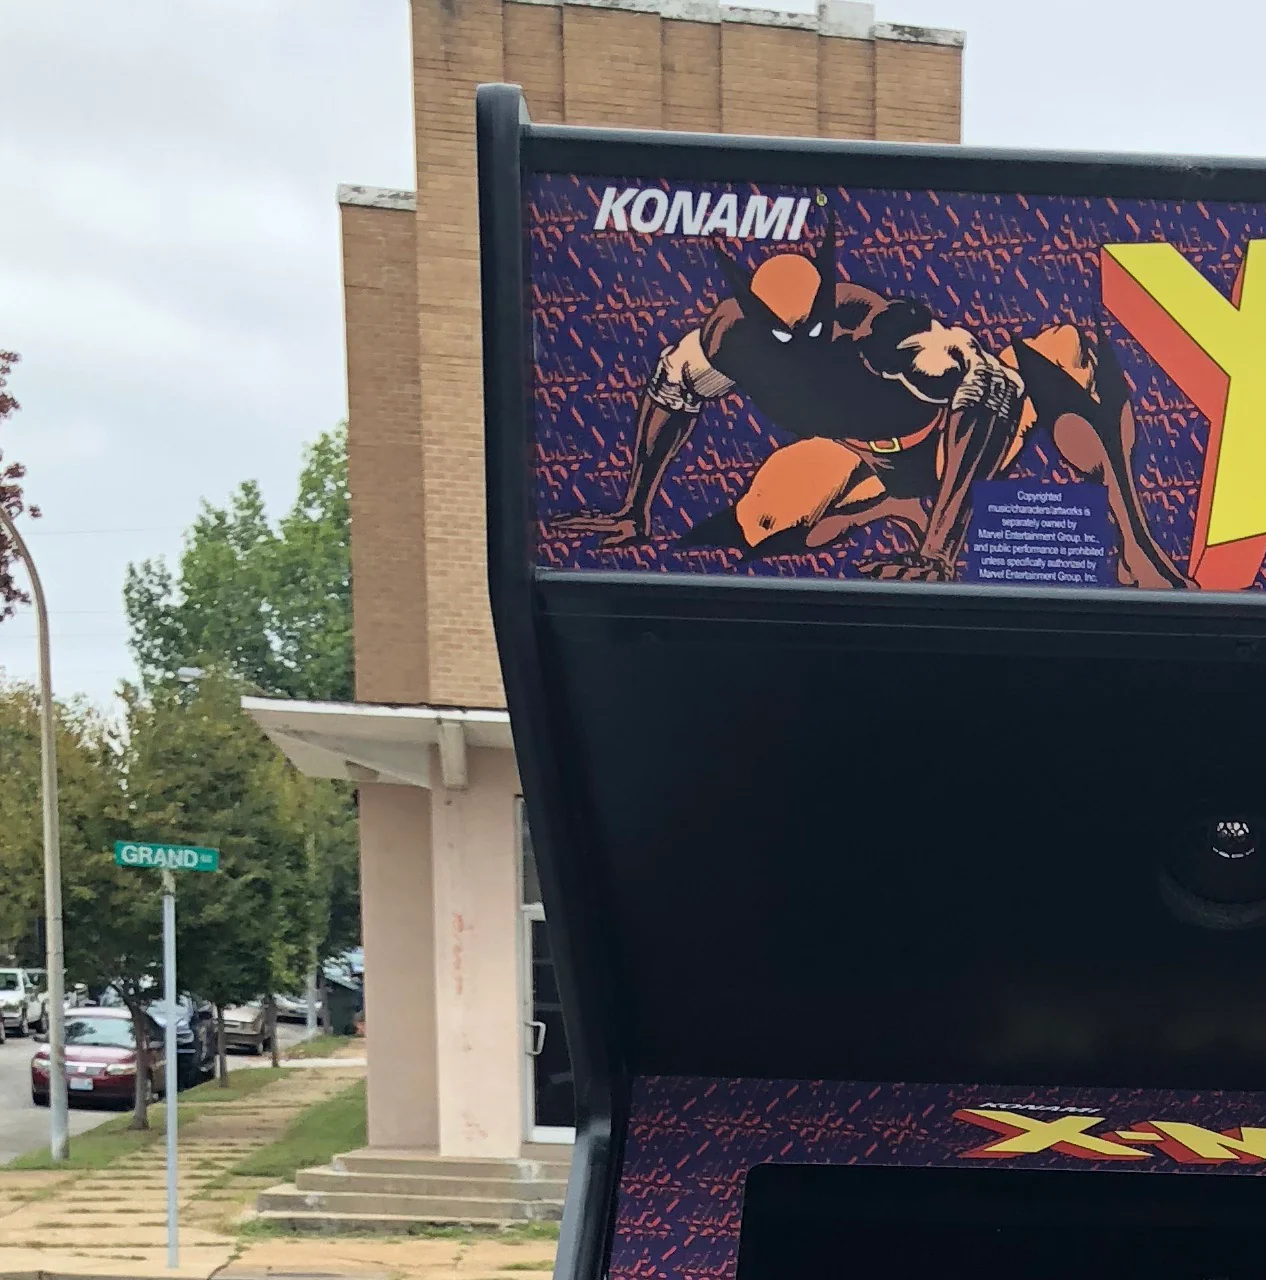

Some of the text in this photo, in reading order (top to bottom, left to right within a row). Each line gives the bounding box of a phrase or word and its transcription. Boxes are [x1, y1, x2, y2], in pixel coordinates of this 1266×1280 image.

[593, 186, 811, 241] KONAMI
[1017, 490, 1062, 504] Copyrighted
[1083, 505, 1091, 517] is
[1001, 518, 1077, 531] separately owned by
[978, 529, 1004, 539] Marvel
[1005, 529, 1055, 542] Entertainment
[973, 543, 1105, 557] and public performance is prohibited
[981, 556, 1096, 571] unless specifically authorized by
[979, 569, 1004, 579] Marvel
[1005, 569, 1056, 581] Entertainment
[1084, 572, 1098, 582] Inc.
[121, 845, 199, 868] GRAND
